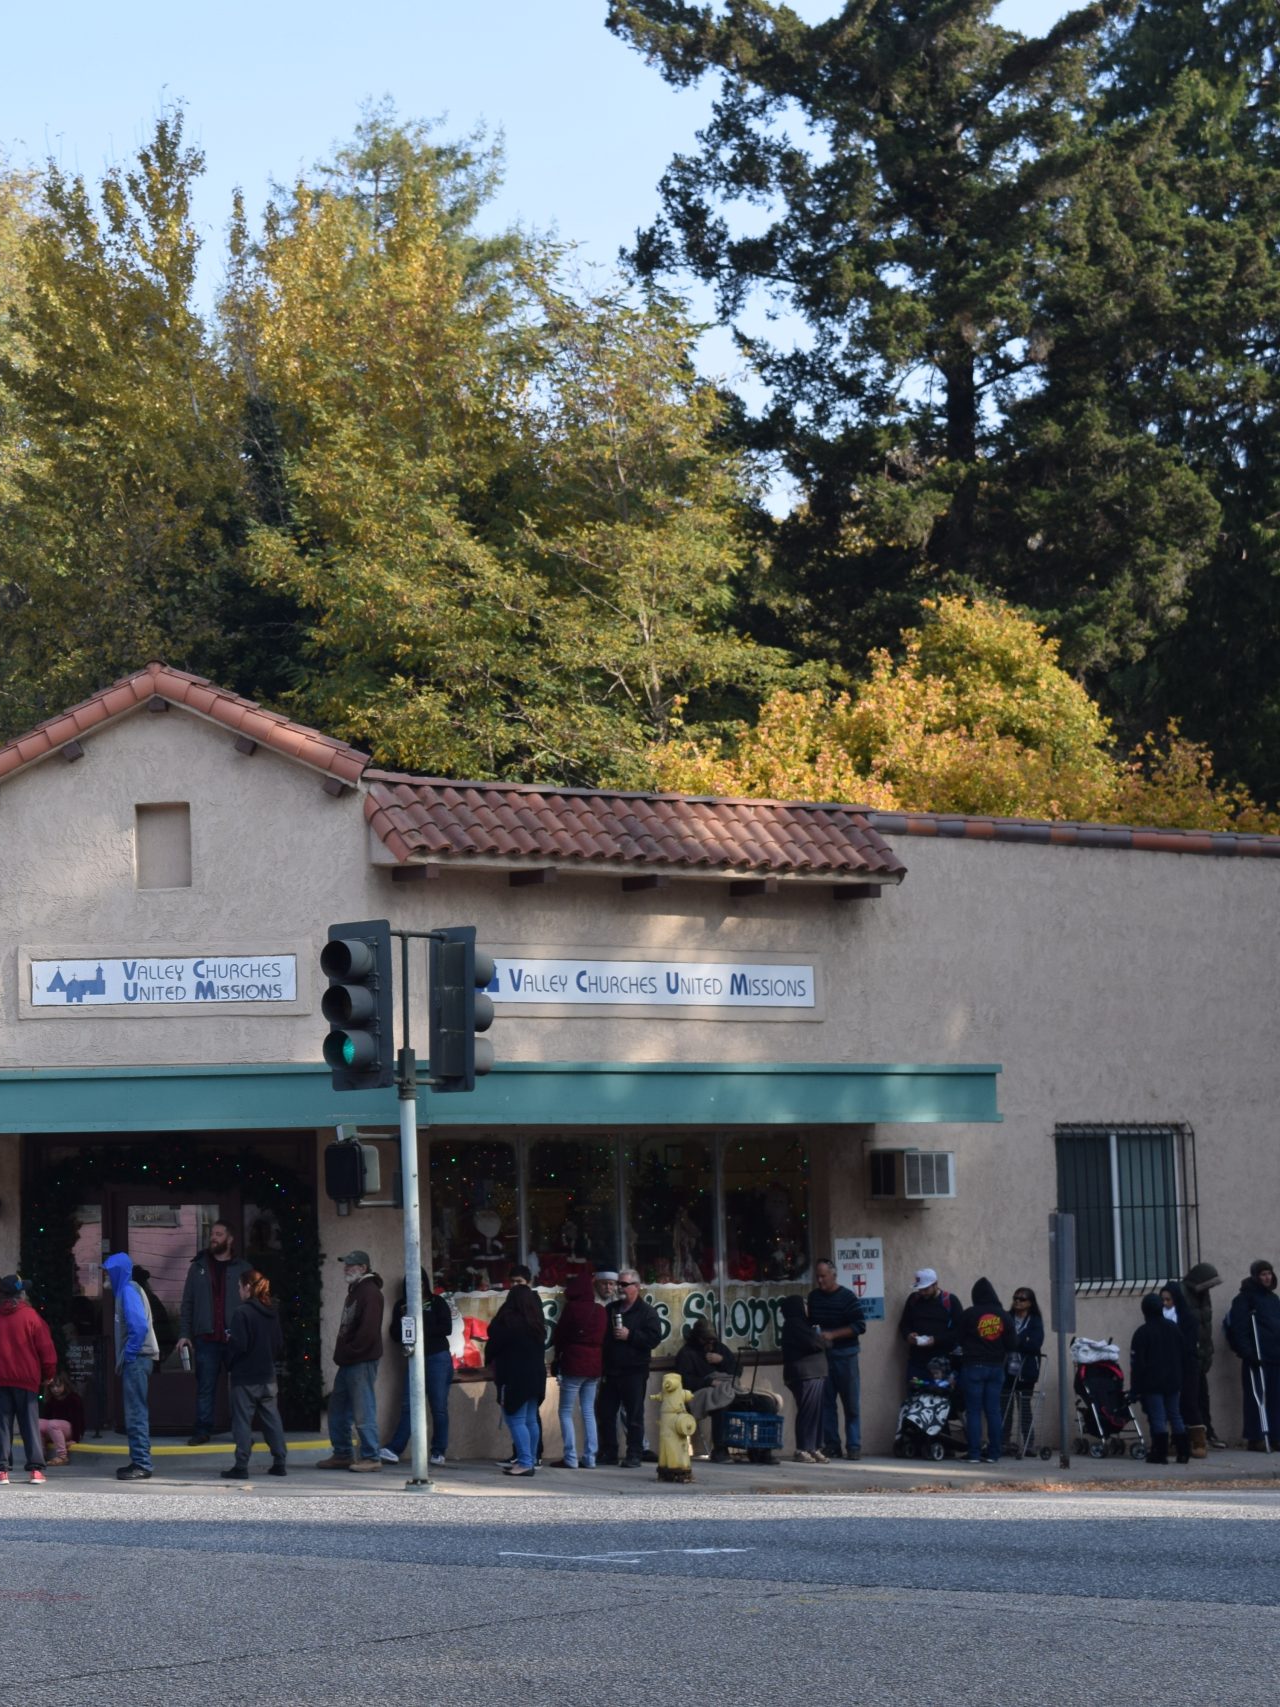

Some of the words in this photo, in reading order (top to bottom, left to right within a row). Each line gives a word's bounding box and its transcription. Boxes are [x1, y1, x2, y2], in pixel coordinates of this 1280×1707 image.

[122, 961, 184, 981] VALLEY
[192, 959, 281, 979] CHURCHES
[123, 982, 186, 1001] UNITED
[194, 979, 283, 1000] MISSIONS
[508, 968, 568, 993] VALLEY
[575, 969, 658, 995] CHURCHES
[665, 971, 723, 996] UNITED
[730, 973, 806, 998] MISSIONS
[837, 1249, 860, 1260] EPISCOPAL
[861, 1248, 879, 1259] CHURCH
[682, 1291, 783, 1347] Shopp
